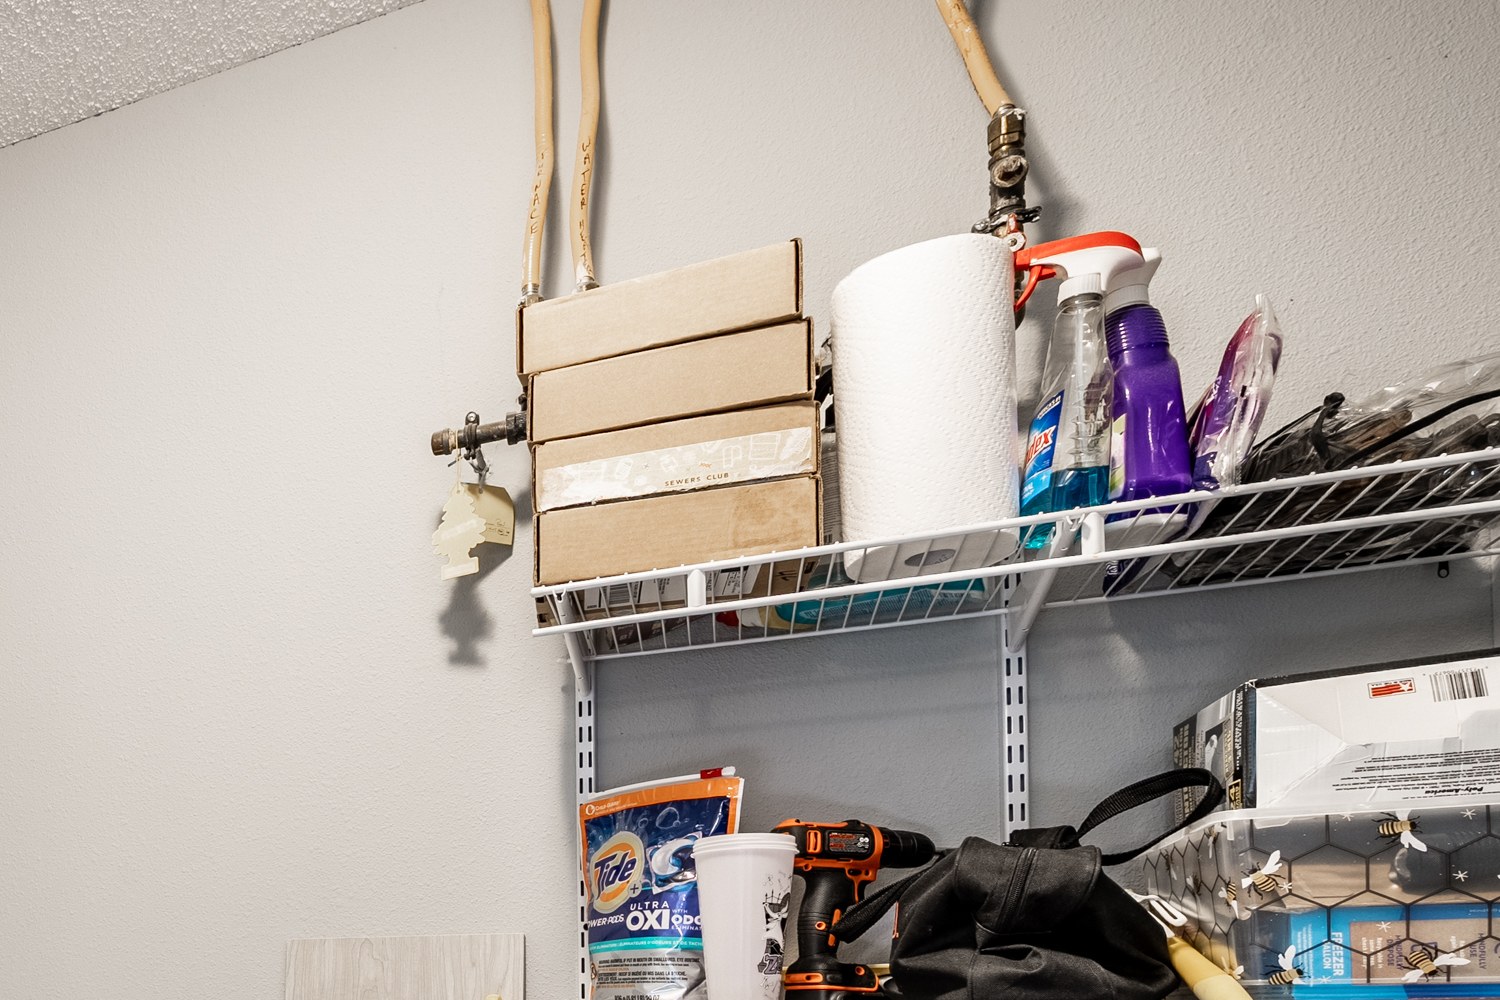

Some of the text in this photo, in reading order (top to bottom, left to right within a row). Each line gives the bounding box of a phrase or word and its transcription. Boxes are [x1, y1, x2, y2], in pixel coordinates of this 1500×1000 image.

[664, 472, 730, 487] SEWERS CLUB
[1424, 786, 1484, 796] Poly-America
[593, 849, 637, 894] Tide
[630, 900, 670, 911] ULTRA
[625, 909, 671, 932] OXI
[671, 914, 702, 926] ODO
[1331, 931, 1345, 976] FREEZER
